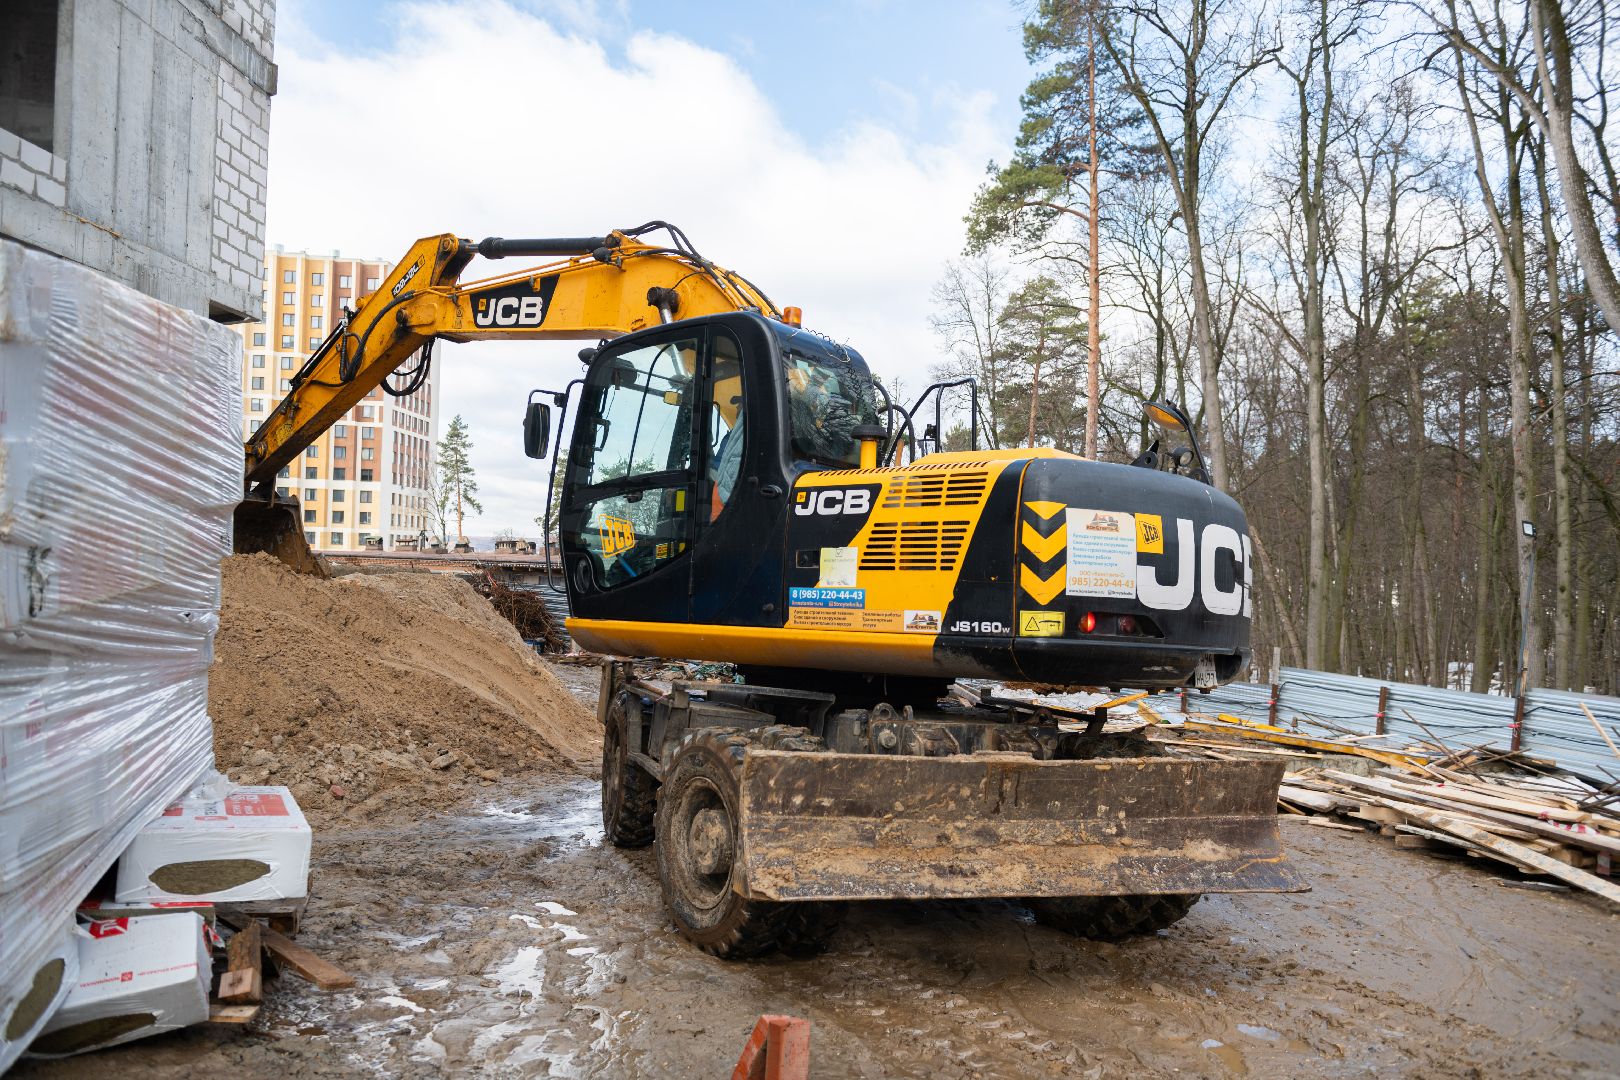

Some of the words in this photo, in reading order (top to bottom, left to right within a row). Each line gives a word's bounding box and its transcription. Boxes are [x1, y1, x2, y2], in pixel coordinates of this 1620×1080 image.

[477, 297, 543, 325] JCB
[795, 489, 870, 515] JCB
[602, 518, 633, 553] JCB
[1143, 523, 1159, 542] JCB
[1137, 518, 1252, 618] JC
[792, 589, 797, 598] 8
[799, 589, 820, 599] (985)
[821, 590, 863, 600] 220-44-43
[1069, 576, 1091, 587] (985)
[1094, 578, 1135, 588] 220-44-43
